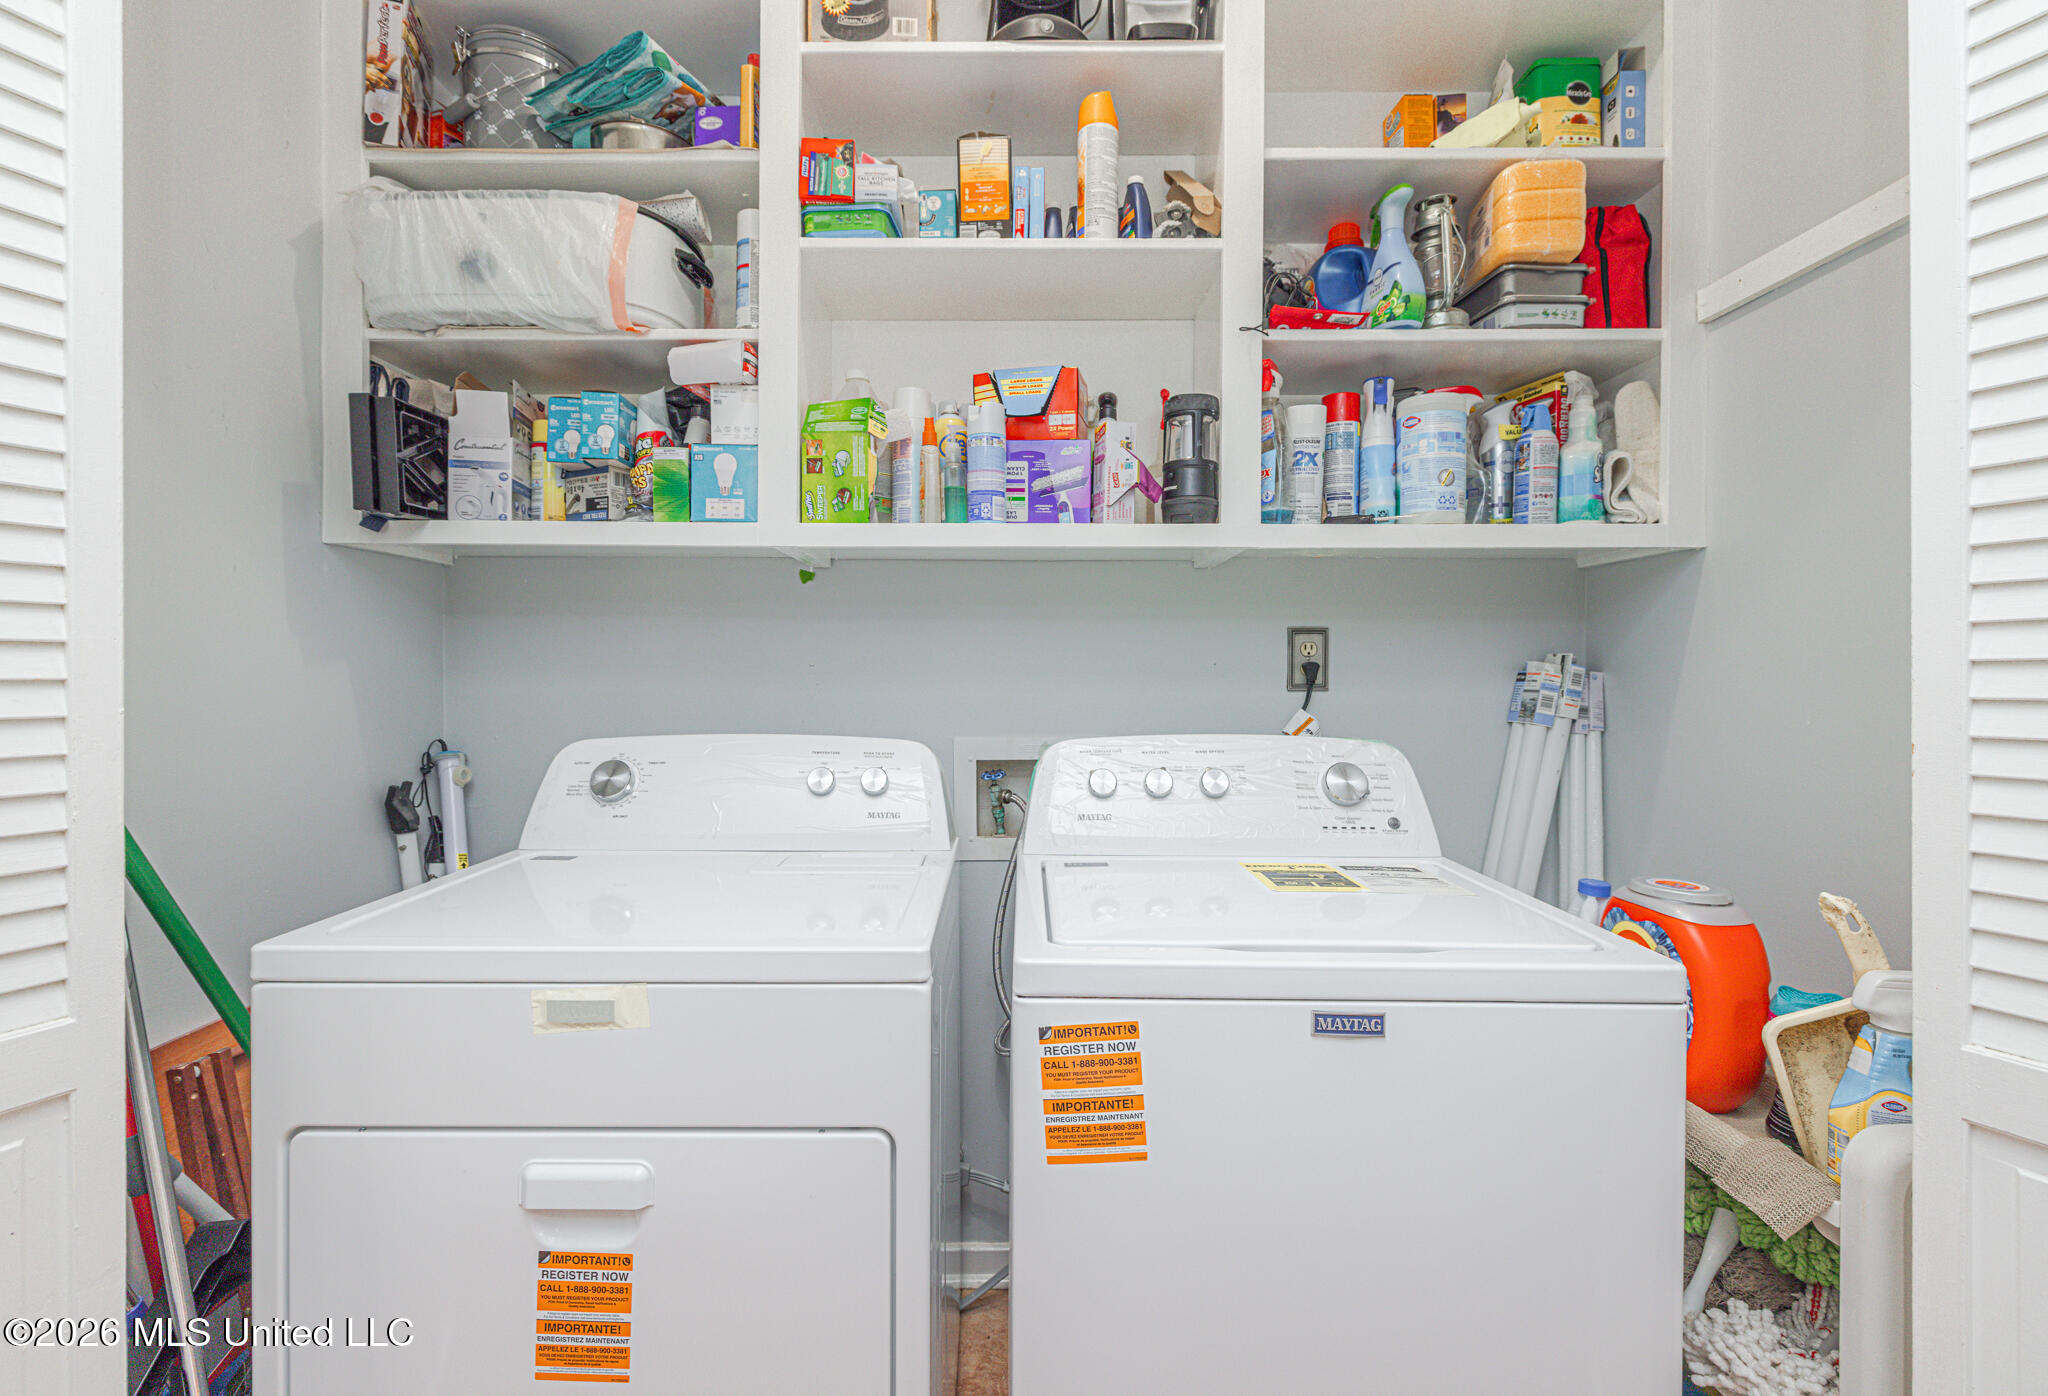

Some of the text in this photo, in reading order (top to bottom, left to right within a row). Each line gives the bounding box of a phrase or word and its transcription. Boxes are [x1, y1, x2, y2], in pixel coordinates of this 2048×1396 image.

[1293, 450, 1319, 467] 2X
[1317, 1018, 1382, 1032] MAYTAG
[1053, 1025, 1127, 1039] IMPORTANT!
[1044, 1041, 1136, 1056] REGISTER NOW
[1044, 1057, 1138, 1070] CALL 1-888-900-3381
[1052, 1099, 1134, 1112] IMPORTANTE!
[1045, 1113, 1144, 1123] ENREGISTREZ MAINTENANT
[552, 1255, 621, 1266] IMPORTANT!
[541, 1270, 629, 1281] REGISTER NOW
[540, 1284, 629, 1294] CALL 1-888-900-3381
[544, 1323, 621, 1334] IMPORTANTE!
